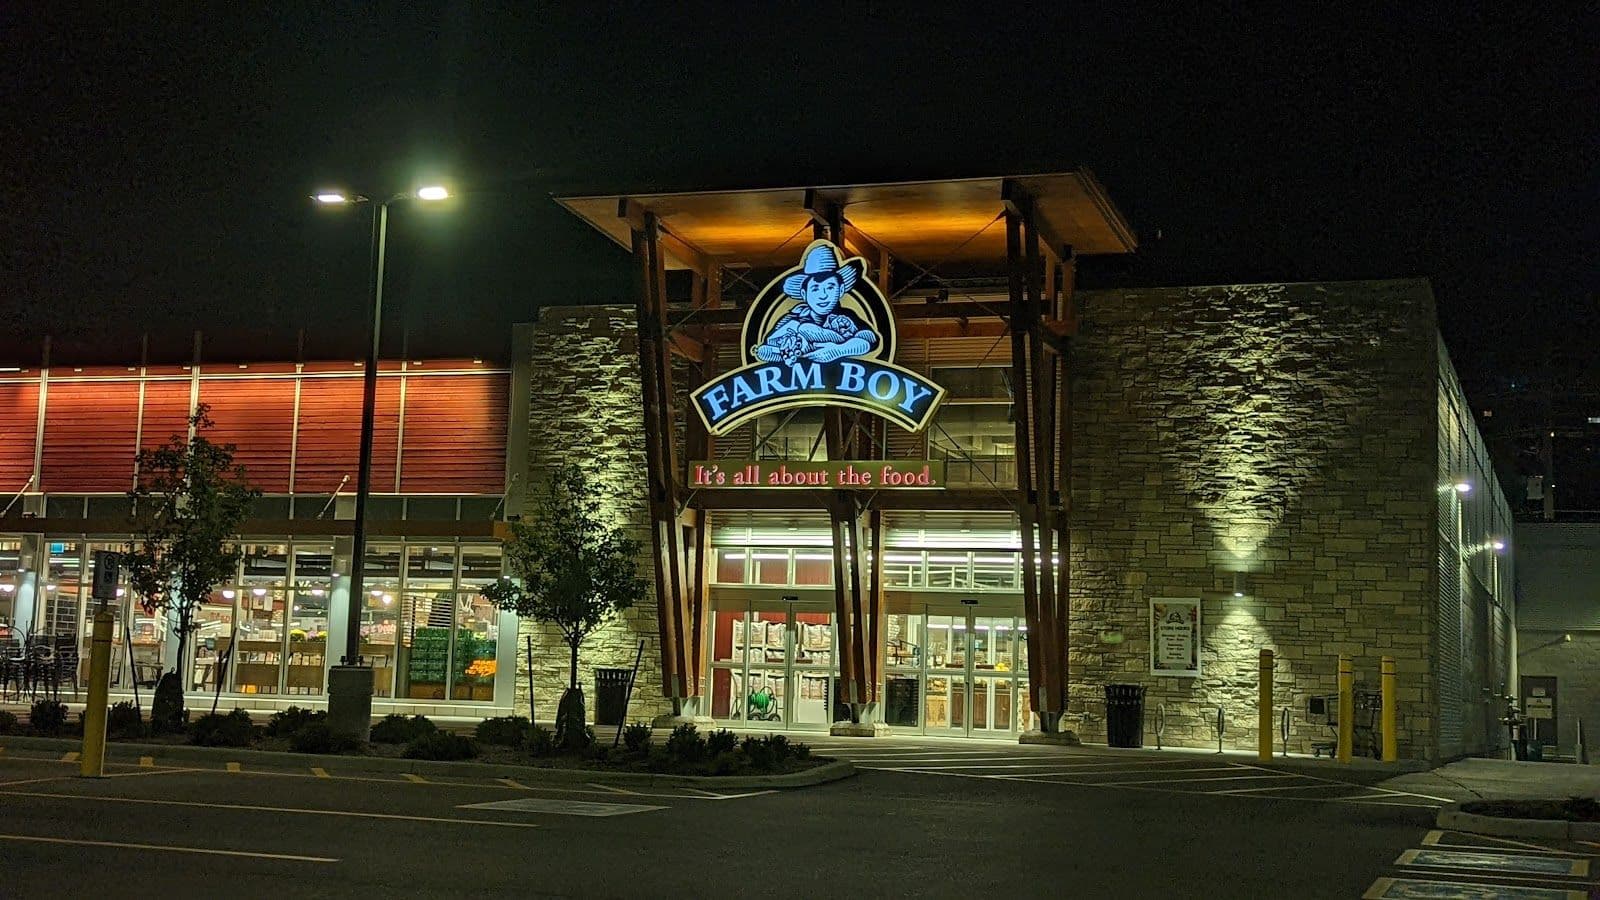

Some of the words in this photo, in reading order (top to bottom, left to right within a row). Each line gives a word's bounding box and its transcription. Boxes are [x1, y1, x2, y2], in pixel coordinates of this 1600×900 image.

[702, 362, 825, 421] FARM
[836, 362, 932, 413] BOY
[694, 465, 726, 485] It's
[733, 465, 760, 485] all
[768, 465, 828, 485] about
[837, 465, 872, 485] the
[880, 465, 937, 485] food.
